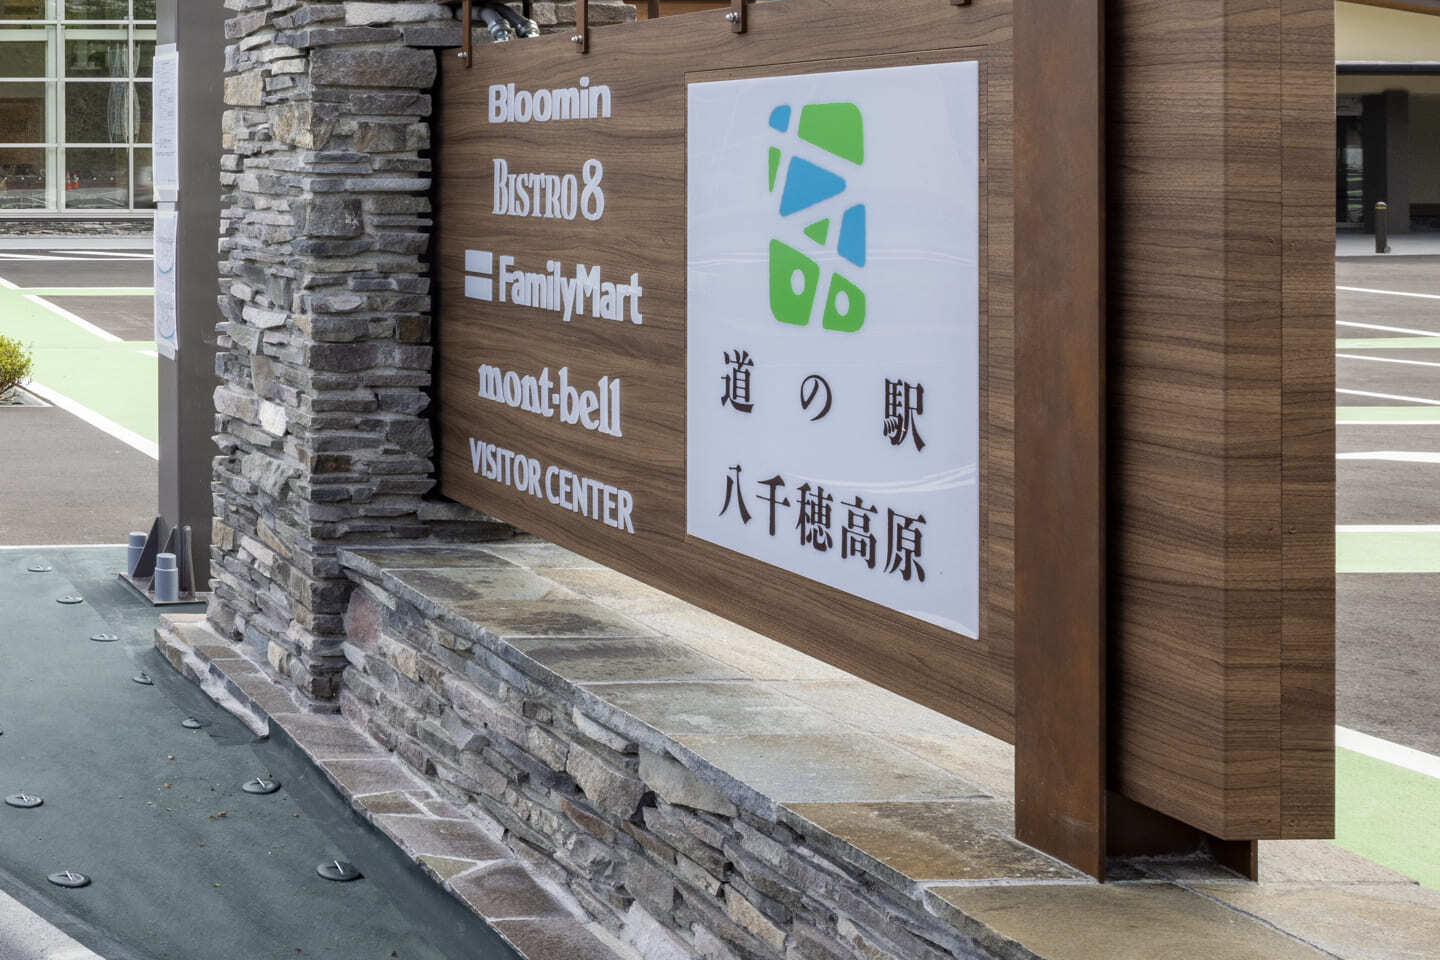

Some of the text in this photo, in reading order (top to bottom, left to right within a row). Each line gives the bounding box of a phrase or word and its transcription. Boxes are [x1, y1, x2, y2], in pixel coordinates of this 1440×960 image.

[488, 76, 611, 123] Bloomin
[498, 255, 643, 325] FamilyMart
[478, 363, 622, 437] mont-bell
[469, 437, 635, 534] VISITOR CENTER
[718, 464, 927, 582] 八千穂高原
